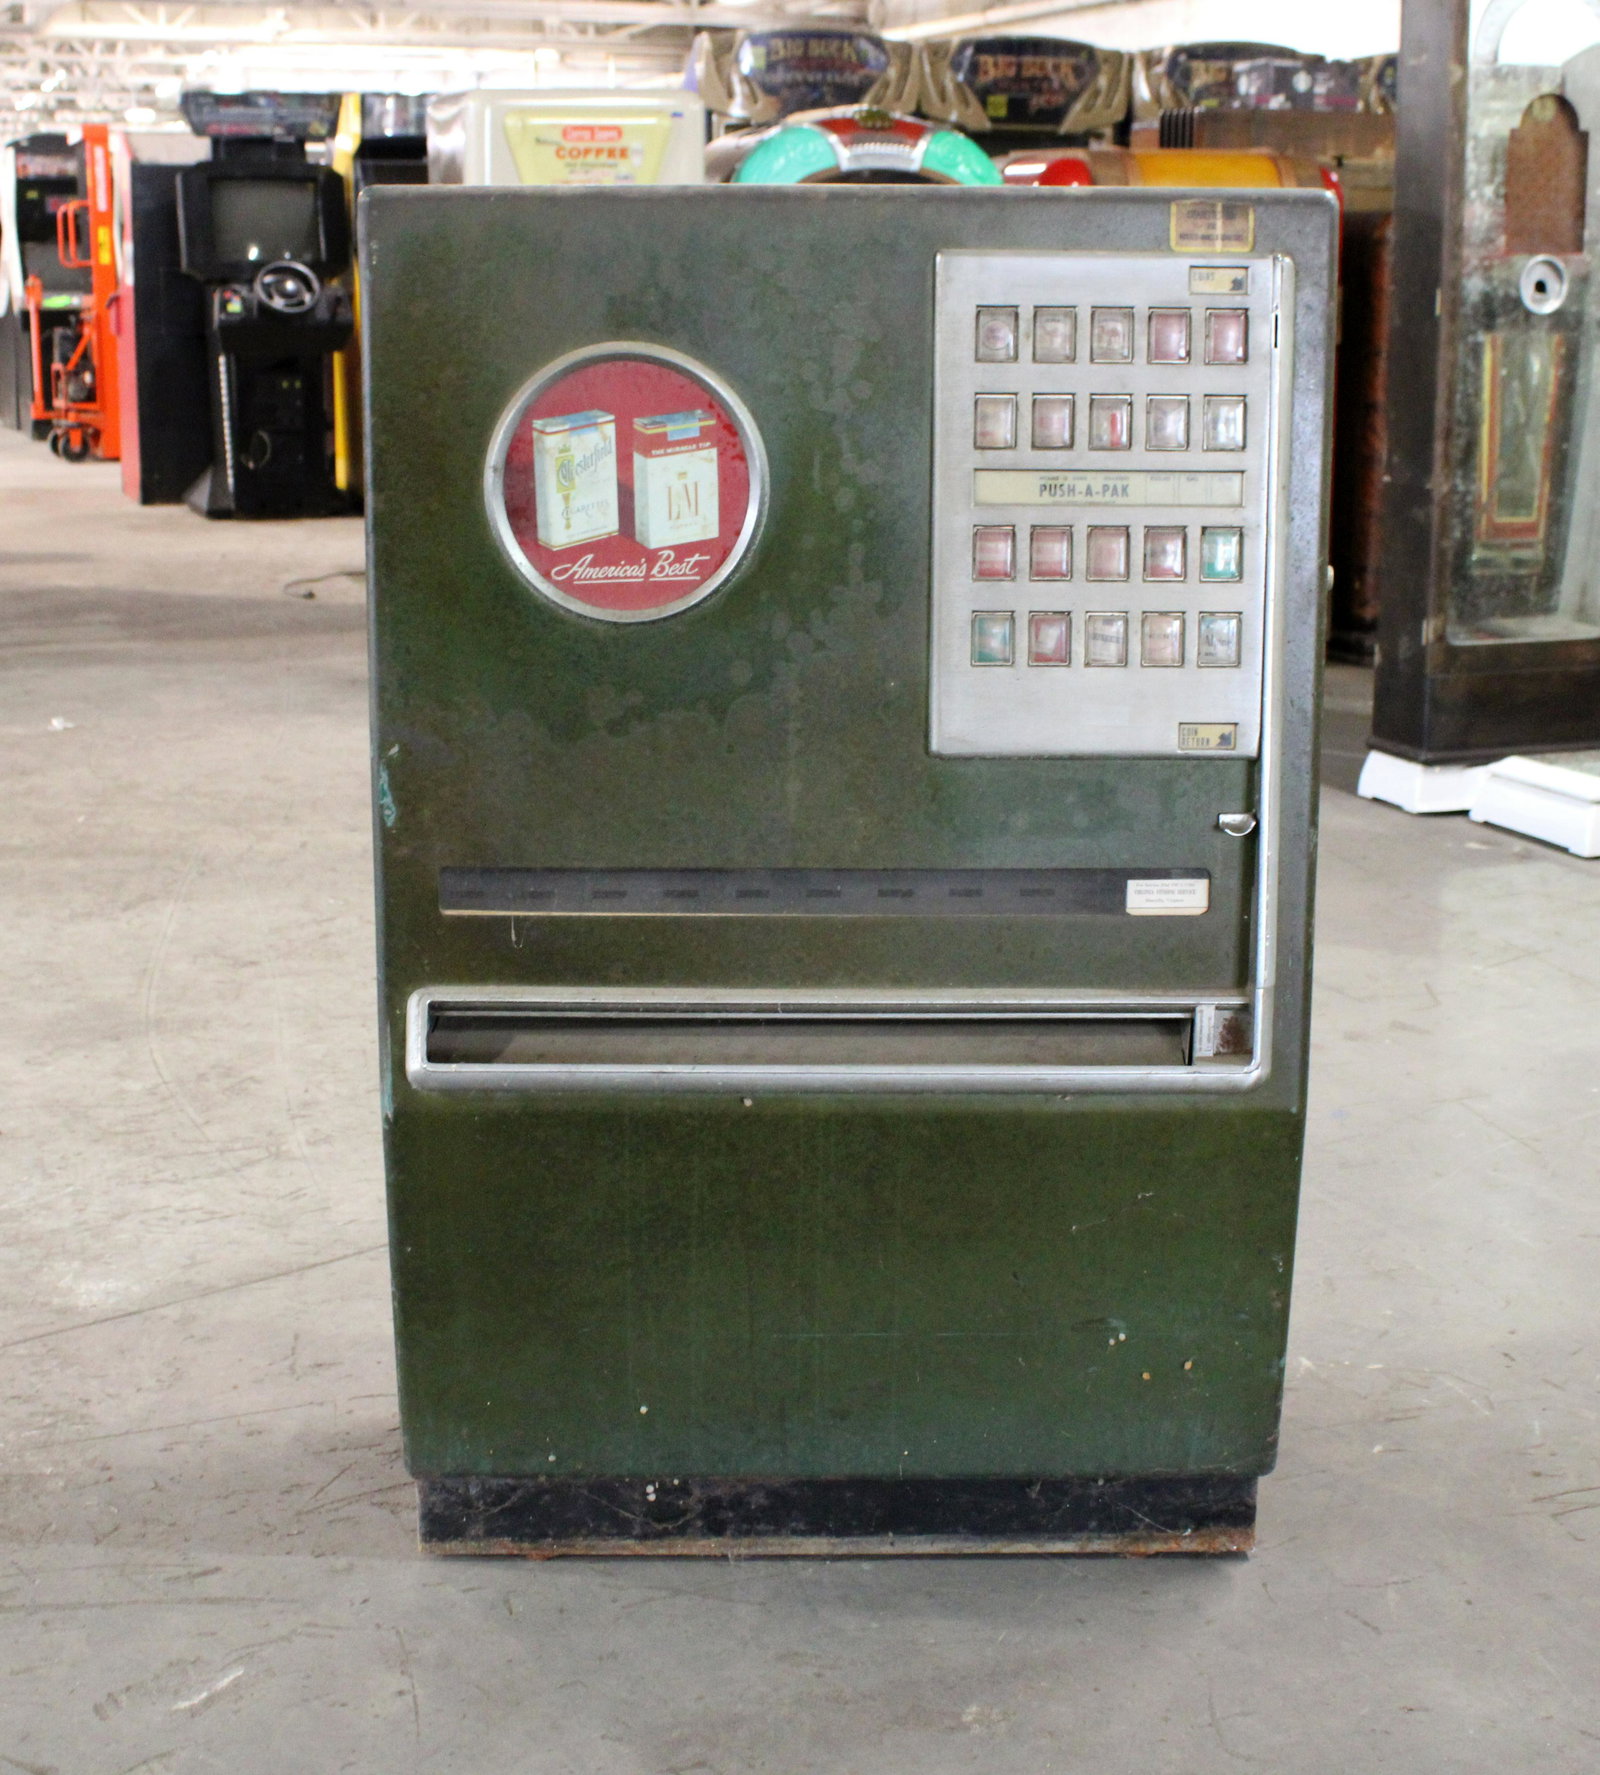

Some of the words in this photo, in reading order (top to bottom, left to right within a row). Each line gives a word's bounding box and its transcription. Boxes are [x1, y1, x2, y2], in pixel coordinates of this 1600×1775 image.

[770, 38, 804, 61] BIG
[555, 146, 629, 160] COFFEE
[557, 435, 613, 488] Chesterfield
[1039, 483, 1130, 498] PUSH-A-PAK
[551, 553, 647, 581] America's
[650, 550, 711, 578] Best
